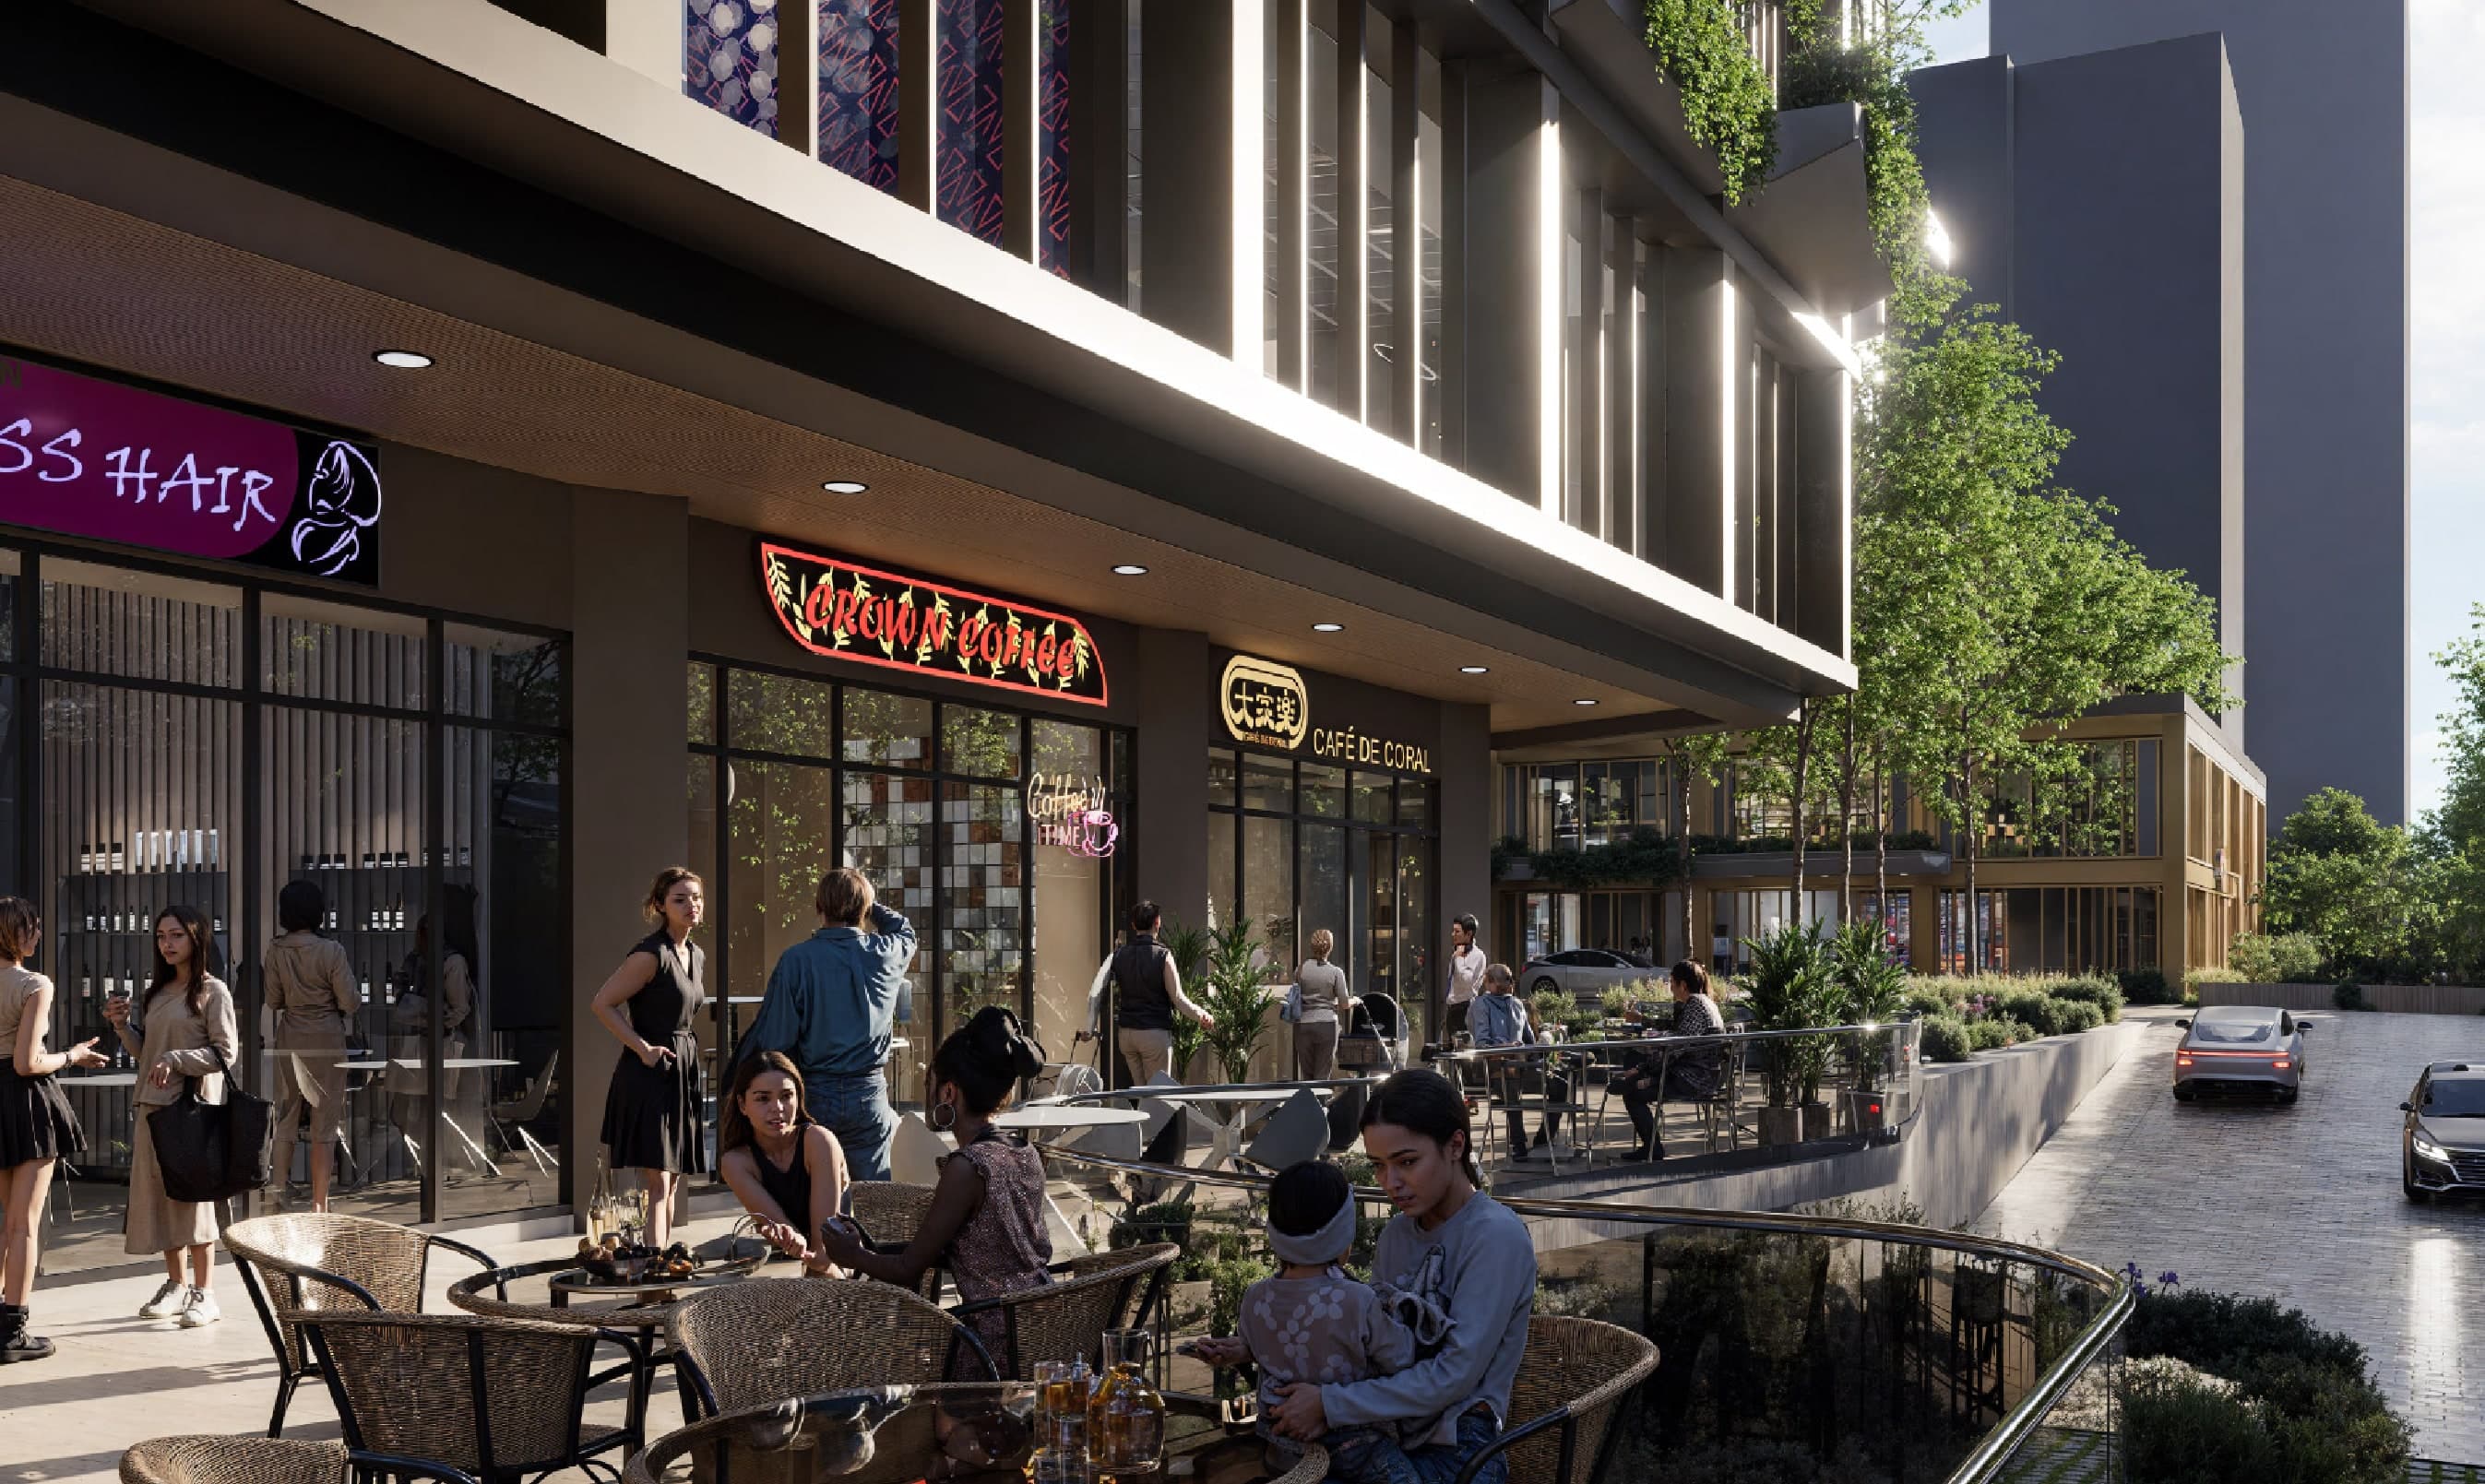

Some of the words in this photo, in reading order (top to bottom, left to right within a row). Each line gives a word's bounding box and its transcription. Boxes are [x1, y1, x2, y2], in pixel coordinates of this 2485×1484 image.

[105, 446, 277, 531] HAIR
[805, 584, 948, 651] CROWN
[958, 617, 1077, 677] COFFEE
[1313, 726, 1356, 761] CAFÉ
[1359, 735, 1382, 766] DE
[1384, 740, 1432, 773] CORAL
[1027, 772, 1088, 821] Coffee
